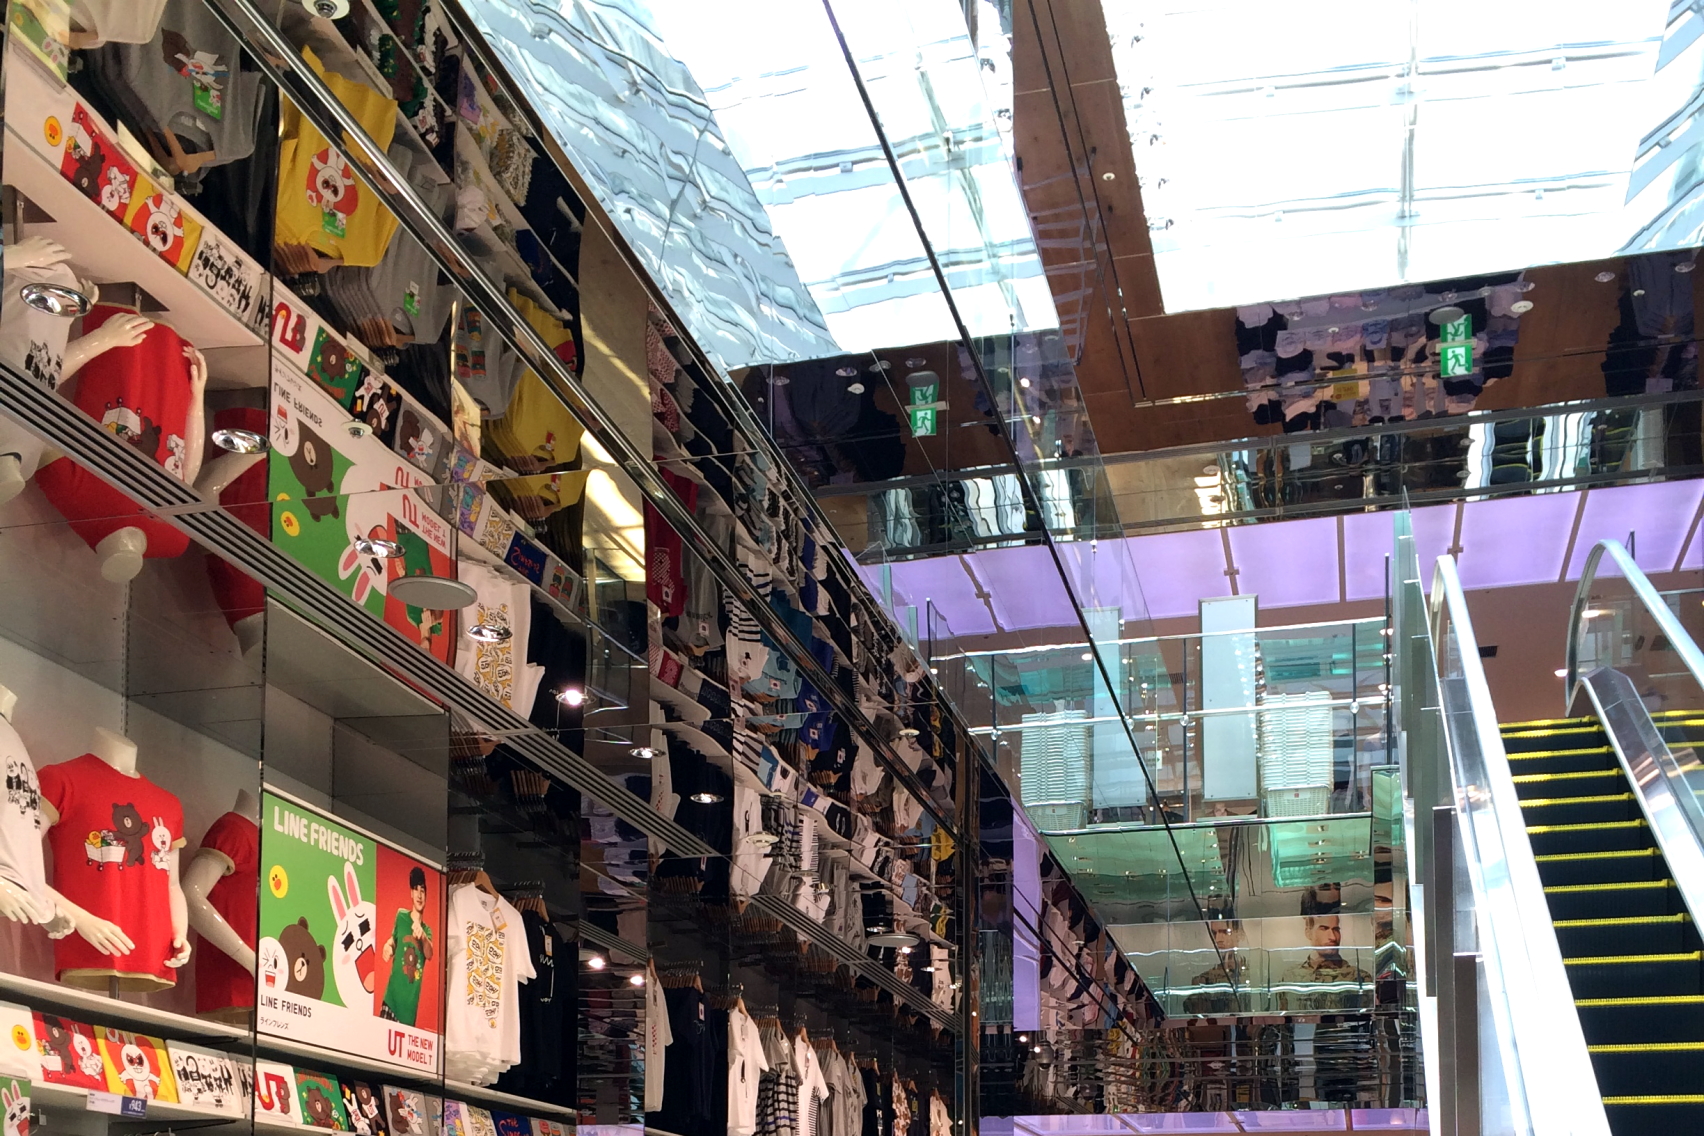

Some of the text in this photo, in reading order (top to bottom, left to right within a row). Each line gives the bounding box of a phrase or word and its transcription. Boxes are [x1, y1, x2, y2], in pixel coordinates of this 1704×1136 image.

[273, 806, 364, 866] LINE FRIENDS
[260, 994, 312, 1018] LINE FRIENDS
[259, 1016, 289, 1031] ラインフレンズ
[388, 1028, 406, 1058] UT
[408, 1034, 433, 1051] THE NEW
[407, 1048, 428, 1064] MODEL
